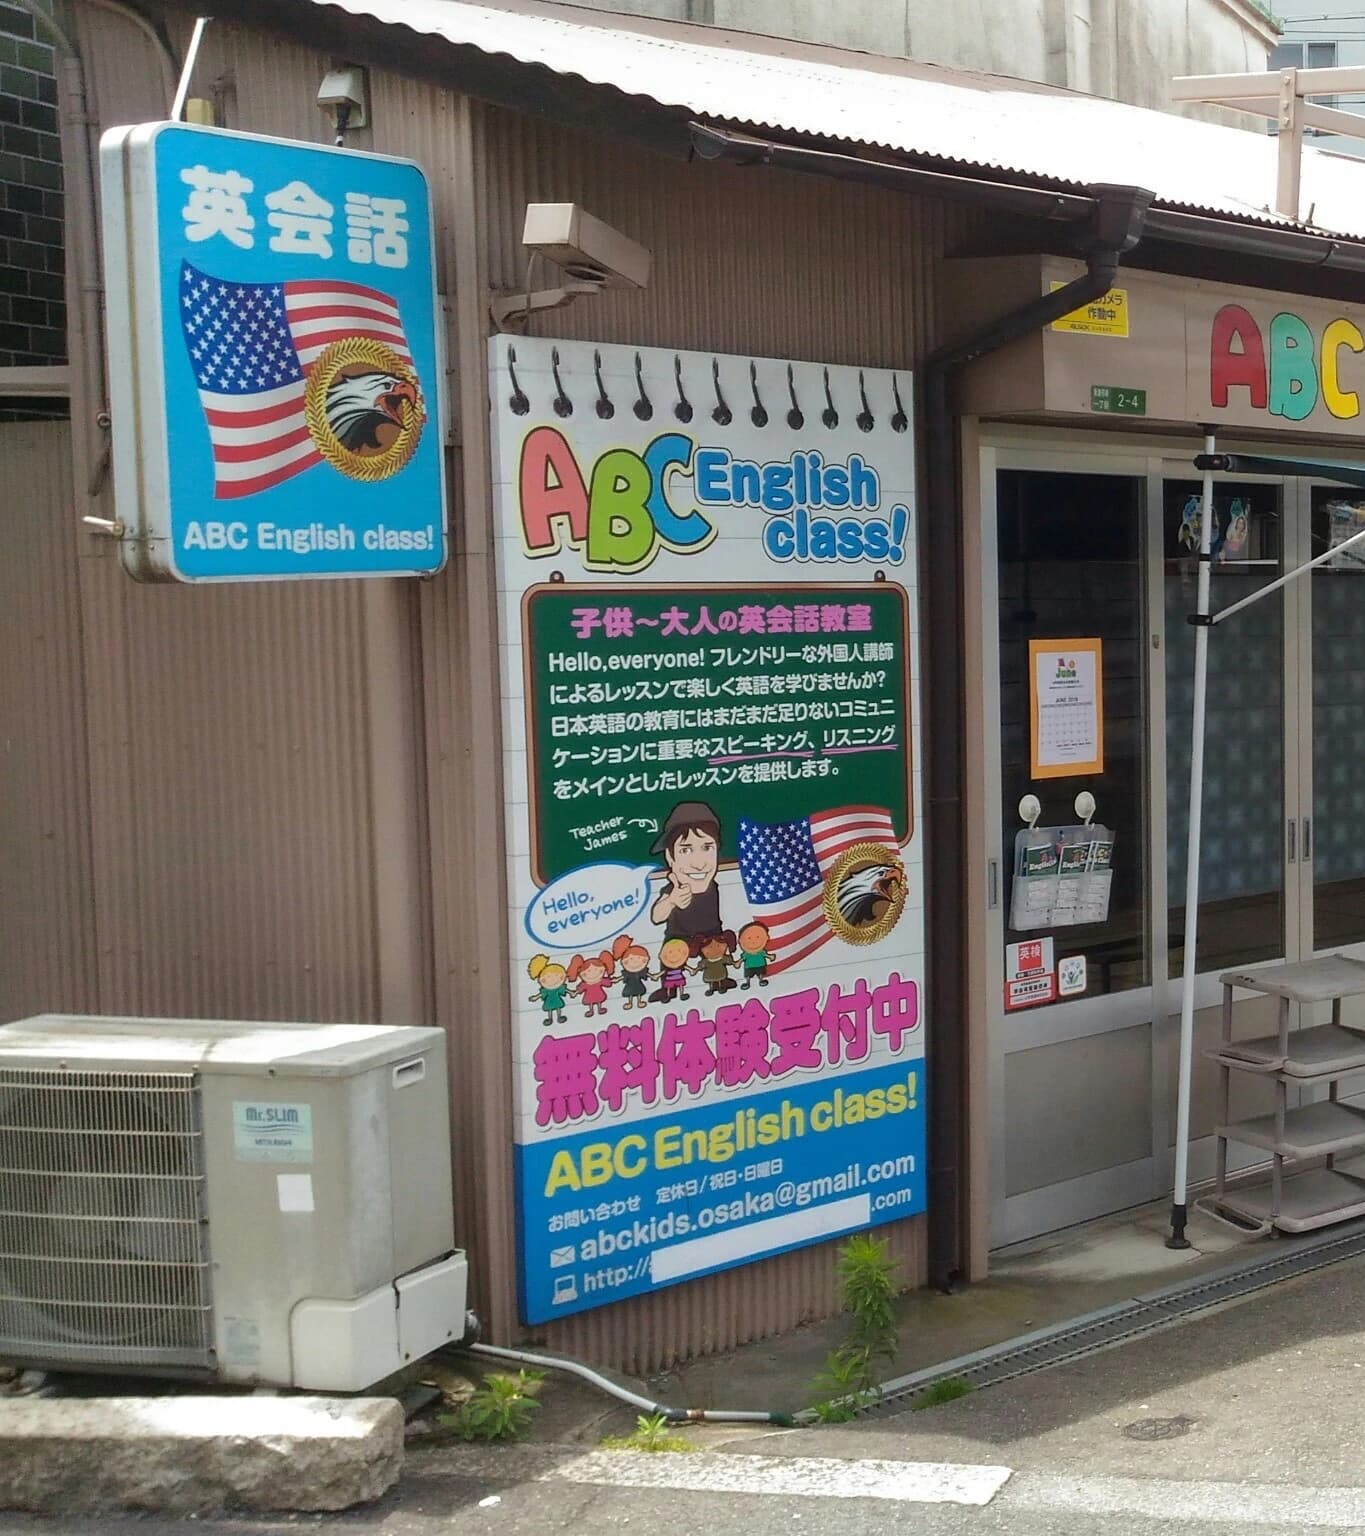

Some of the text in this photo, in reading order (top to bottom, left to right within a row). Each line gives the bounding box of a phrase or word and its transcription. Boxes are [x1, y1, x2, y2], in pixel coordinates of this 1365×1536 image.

[180, 164, 409, 269] 英会話
[1211, 303, 1365, 421] ABC
[1118, 394, 1139, 409] 2-4
[519, 426, 879, 568] ABC English
[183, 521, 434, 554] ABC English class!
[765, 505, 909, 564] class!
[710, 642, 895, 668] フレンドリーな外国人講師
[551, 698, 896, 738] 日本英語の教育にはまだまだ足りないコミュニ
[552, 757, 841, 800] をメインとしたレッスンを提供します。
[567, 814, 625, 838] Teacher
[583, 829, 629, 852] James
[541, 888, 596, 916] Hello,
[546, 887, 641, 935] everyone!
[1019, 944, 1041, 960] 英検
[532, 972, 918, 1126] 無料体験受付中
[544, 1072, 918, 1198] ABC English class!
[547, 1194, 642, 1233] お問い合わせ
[579, 1155, 916, 1262] abckids.osaka@gmail.com
